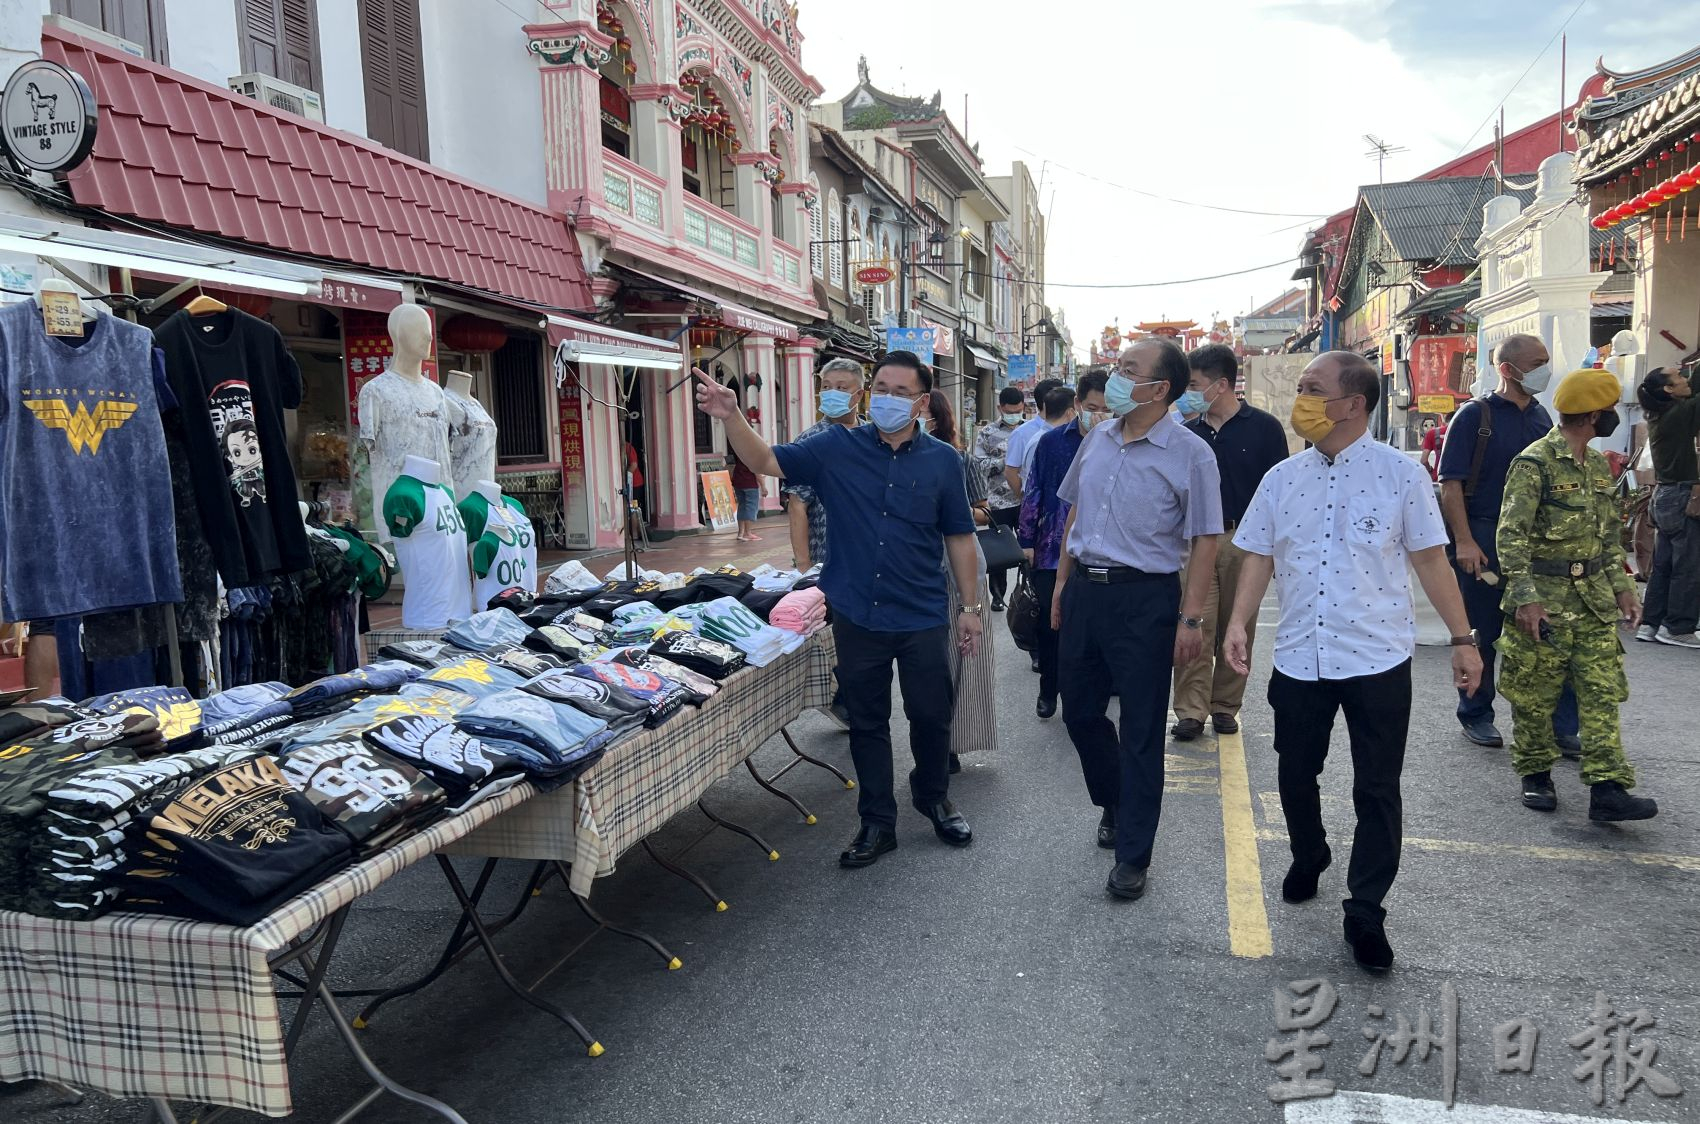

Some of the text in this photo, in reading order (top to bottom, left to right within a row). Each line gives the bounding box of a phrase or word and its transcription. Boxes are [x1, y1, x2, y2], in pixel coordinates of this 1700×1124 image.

[13, 120, 77, 139] VINTAGE STYLE
[39, 138, 52, 150] 88
[22, 388, 136, 398] WONDER WOMAN
[214, 726, 254, 747] ARMANI
[151, 755, 290, 836] MELAKA
